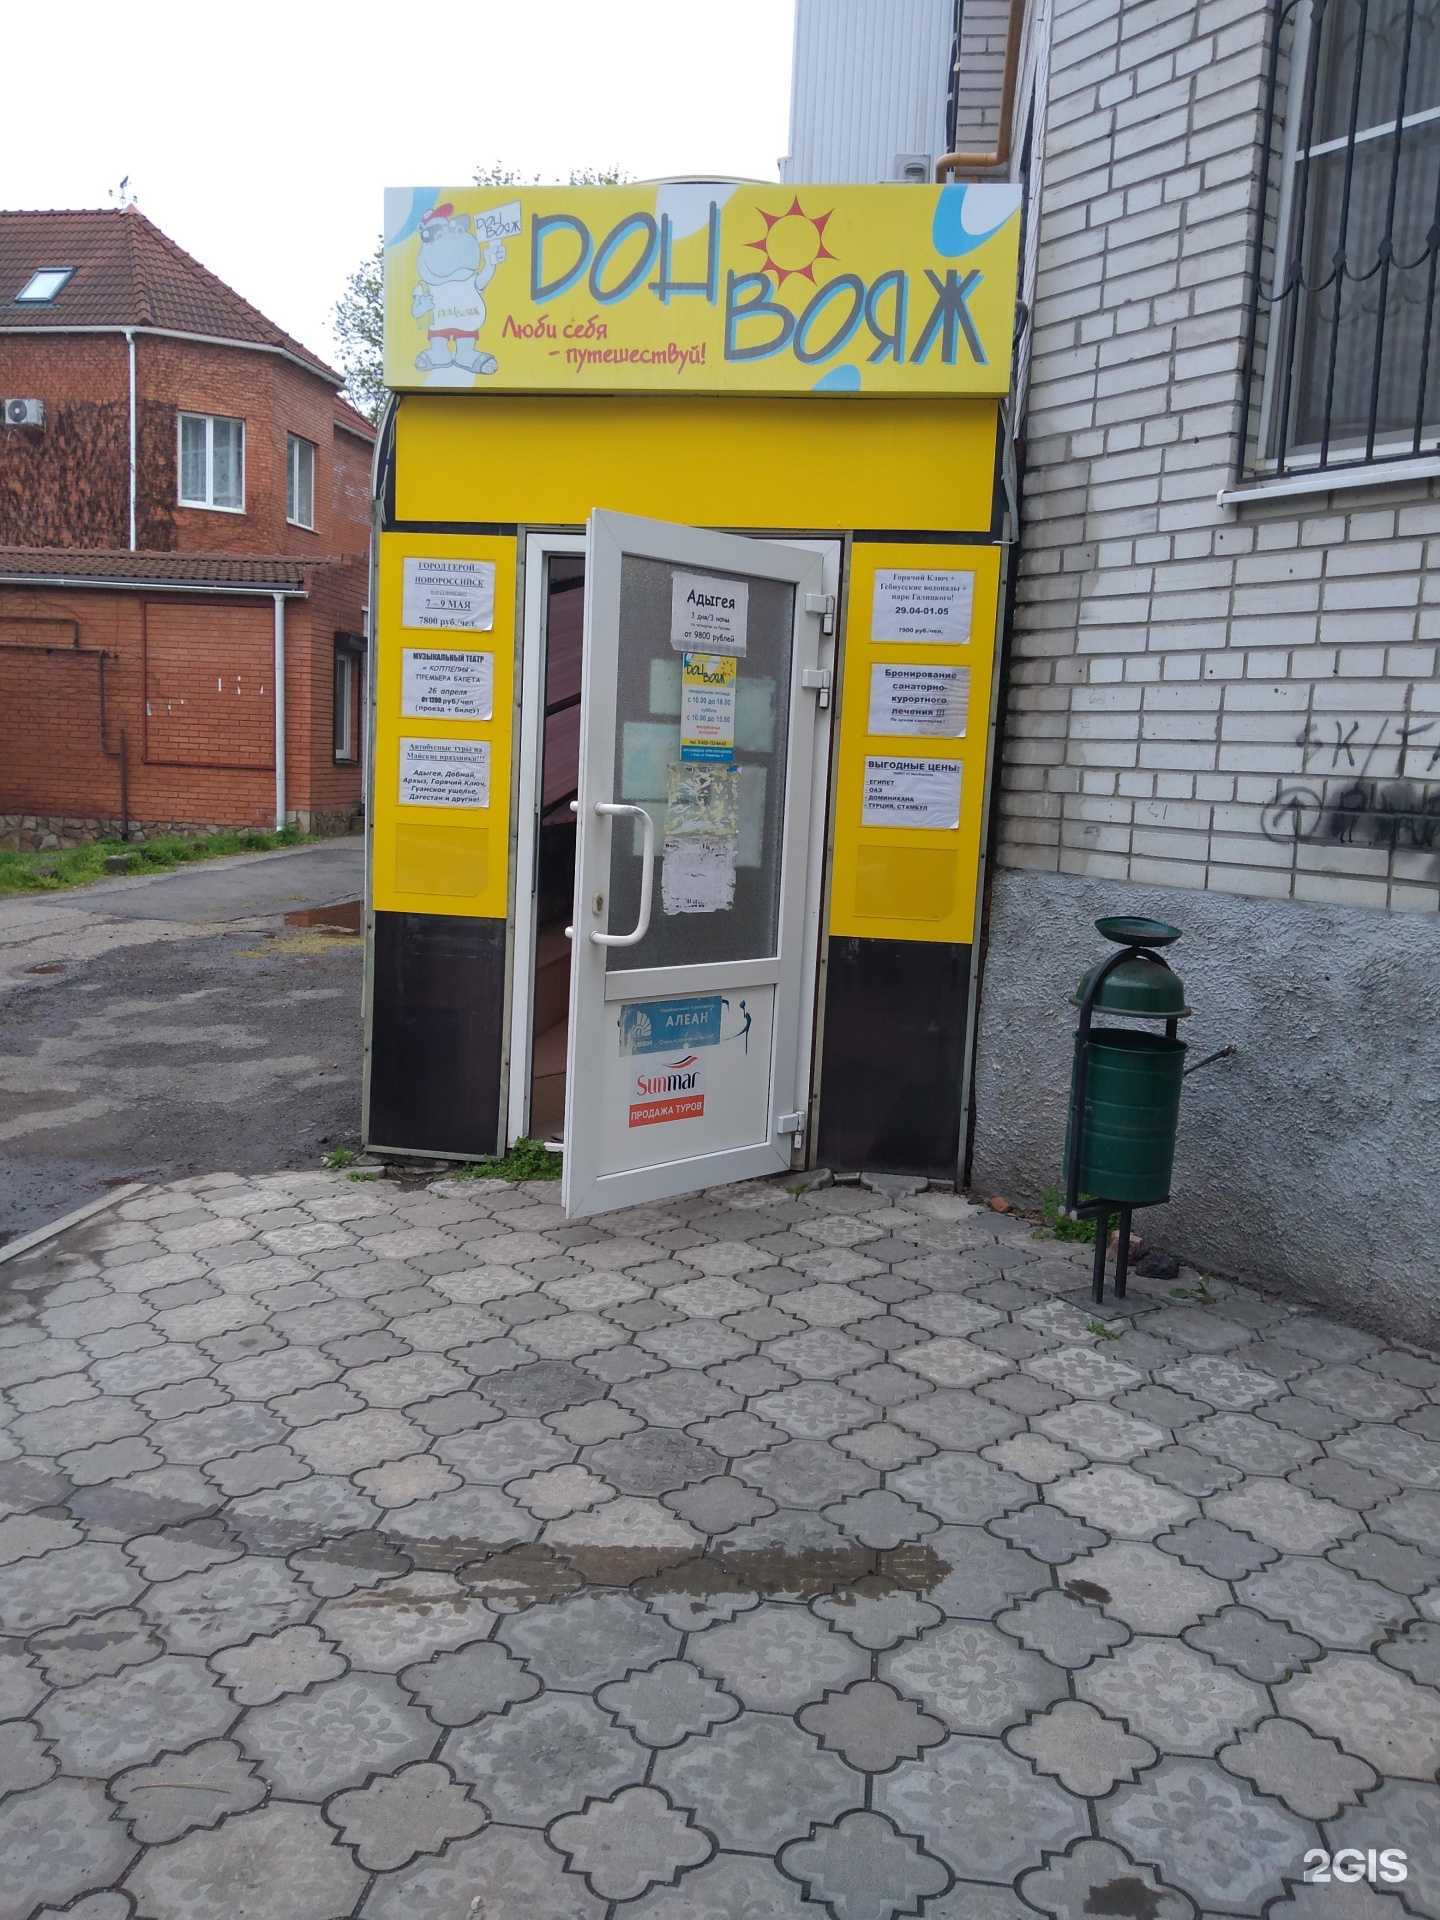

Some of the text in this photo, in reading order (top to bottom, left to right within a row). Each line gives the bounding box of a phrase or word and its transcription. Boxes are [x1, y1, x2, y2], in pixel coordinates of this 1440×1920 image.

[724, 267, 988, 366] ВОЯЖ
[502, 314, 608, 340] Люби себя
[566, 341, 706, 375] путешествуй!
[440, 600, 446, 608] 9
[448, 600, 471, 609] МАЯ
[687, 589, 735, 609] Адыгея
[895, 606, 950, 616] 29.04-01.05
[713, 634, 736, 643] рублей
[413, 652, 485, 664] МУЗЫКАЛЬНЫЙ ТЕАТР
[416, 673, 451, 682] ПРЕМЬЕРА
[885, 669, 957, 679] Бронирование
[892, 682, 949, 693] санаторно-
[891, 695, 948, 705] курортного
[891, 708, 934, 717] лечения
[868, 760, 926, 771] ВЫГОДНЫЕ
[869, 779, 895, 787] ЕГИПЕТ
[868, 795, 914, 803] ДОМИНИКАНА
[666, 1012, 709, 1027] АЛЕАН
[636, 1071, 702, 1097] Sunmar
[631, 1103, 703, 1121] ПРОДАЖА ТУРОВ
